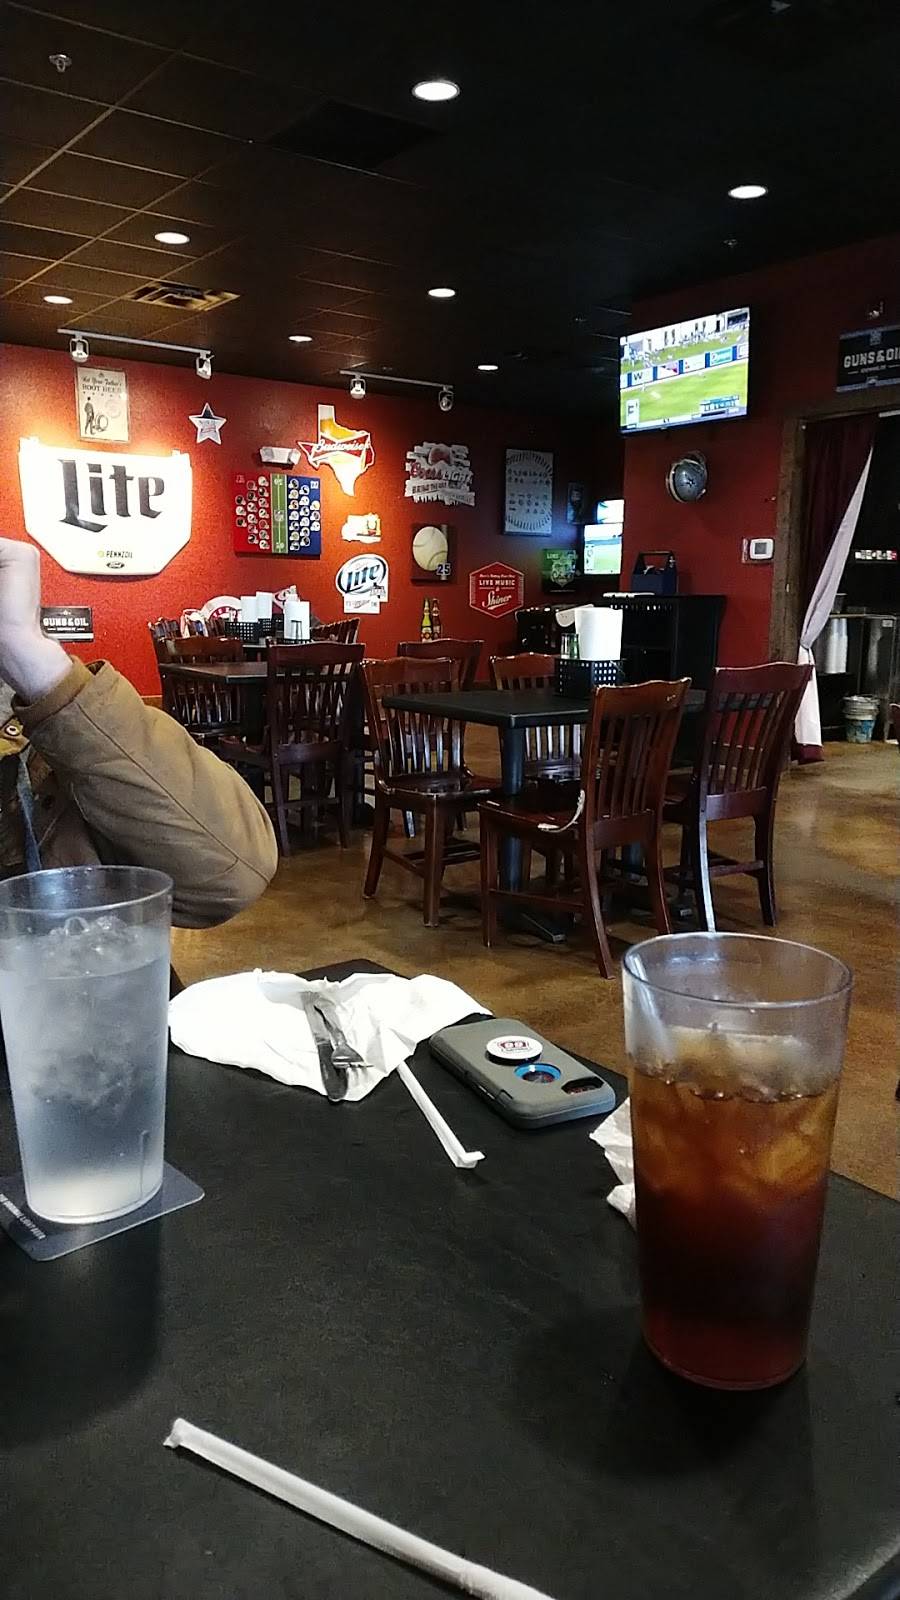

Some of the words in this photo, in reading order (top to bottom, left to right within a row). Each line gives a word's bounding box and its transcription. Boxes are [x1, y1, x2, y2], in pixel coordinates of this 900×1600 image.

[314, 439, 371, 453] Budweiser
[58, 459, 165, 533] Lite
[106, 551, 133, 559] PENNZOIL
[437, 564, 450, 575] 25
[344, 564, 381, 593] Lite
[481, 590, 512, 610] Shiner
